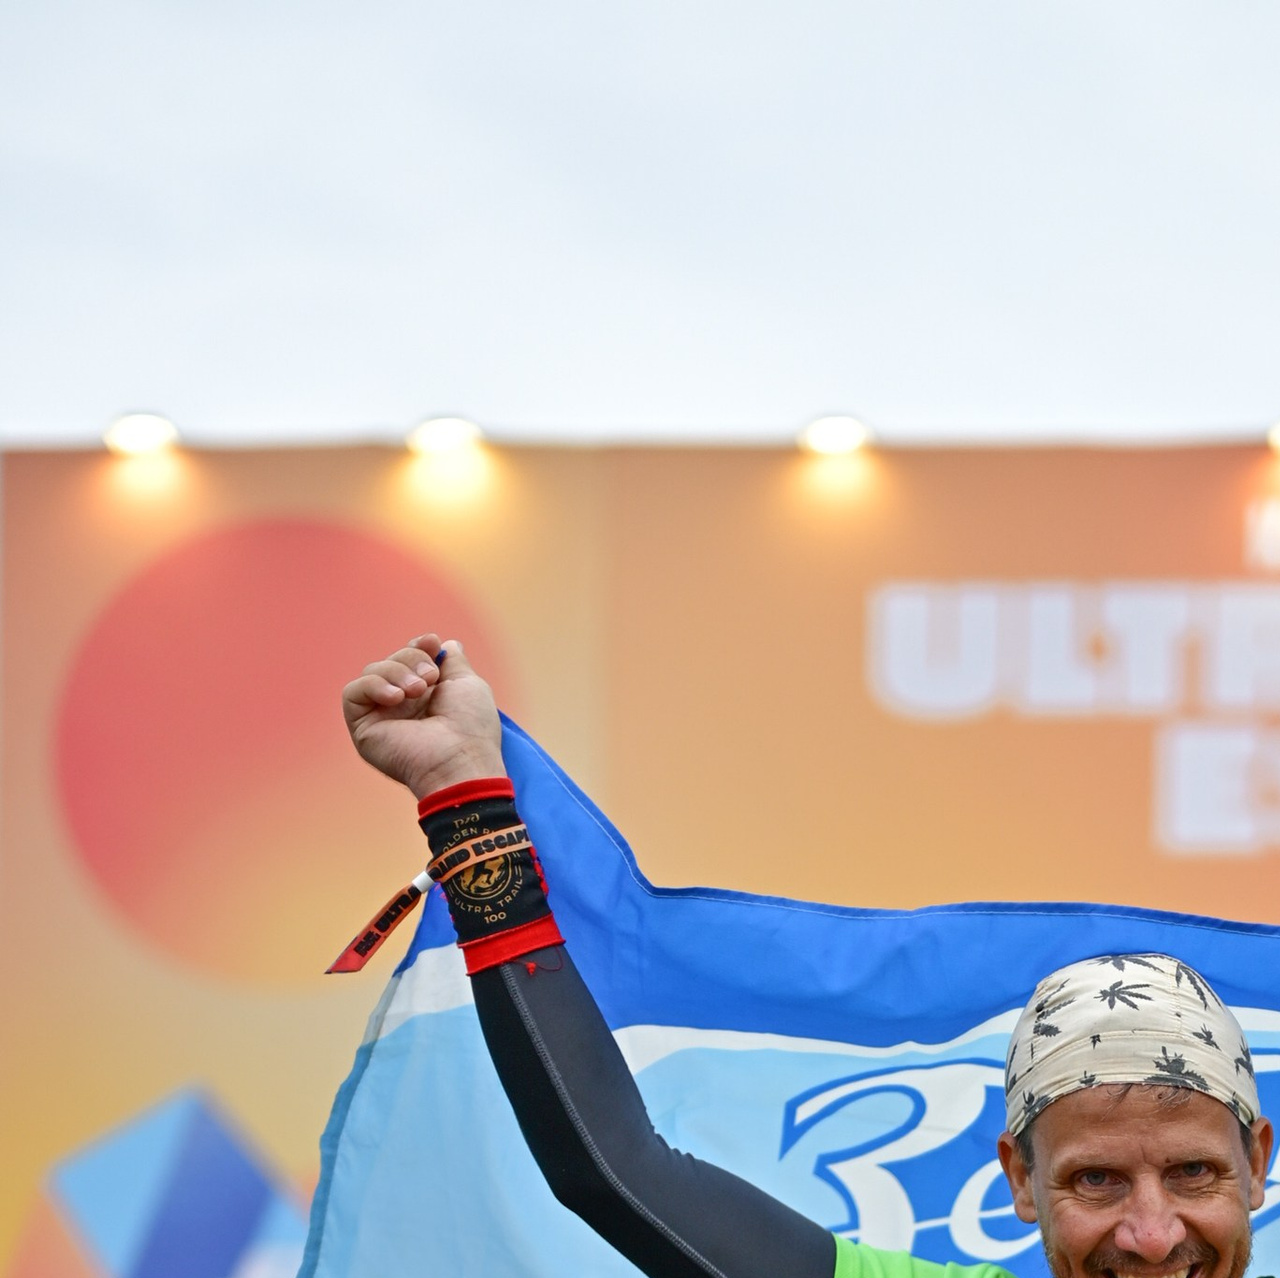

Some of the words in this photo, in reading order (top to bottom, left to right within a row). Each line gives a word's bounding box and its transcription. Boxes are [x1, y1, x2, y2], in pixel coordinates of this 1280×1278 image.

[443, 828, 478, 853] OLDEN
[454, 898, 493, 913] ULTRA
[497, 878, 523, 908] TRAIL
[484, 911, 507, 924] 100
